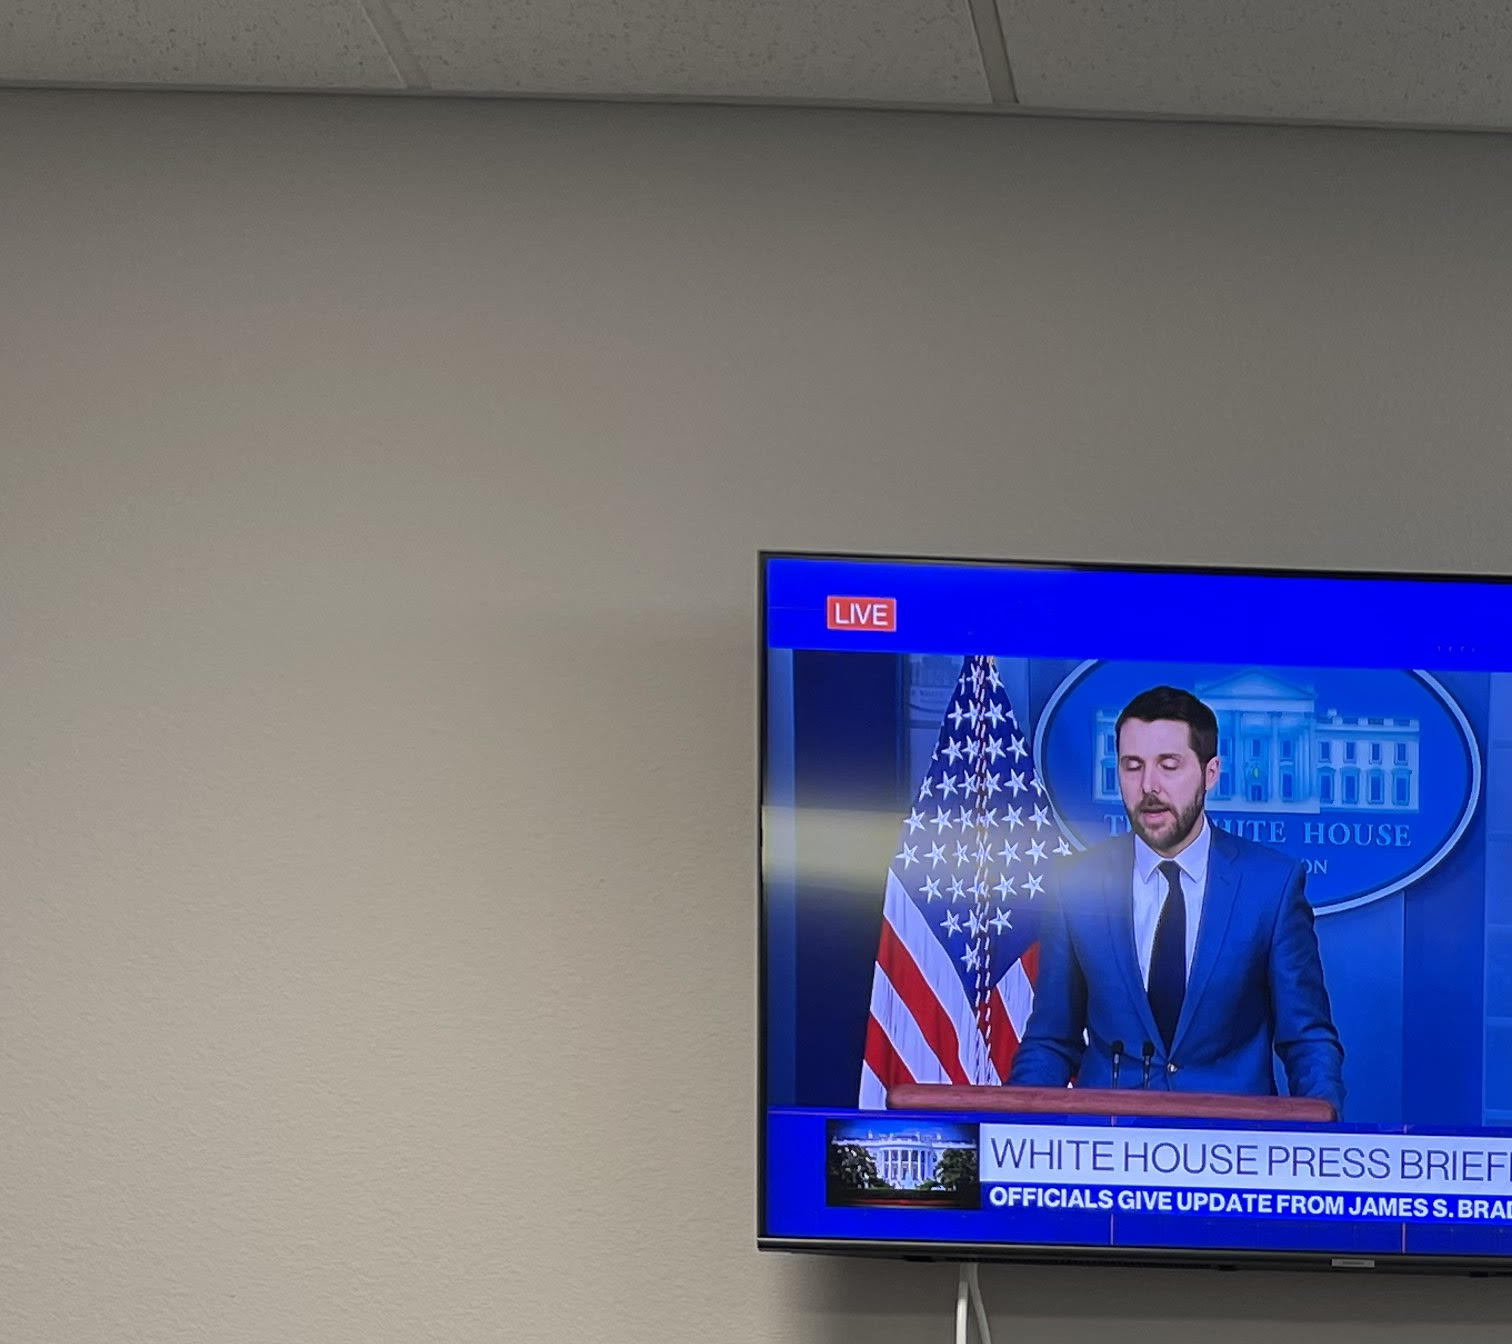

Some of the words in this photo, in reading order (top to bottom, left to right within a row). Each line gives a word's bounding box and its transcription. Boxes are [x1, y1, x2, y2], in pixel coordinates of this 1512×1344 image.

[835, 602, 889, 626] LIVE
[1303, 822, 1412, 848] HOUSE
[989, 1136, 1115, 1172] WHITE
[1123, 1140, 1259, 1176] HOUSE
[1267, 1145, 1392, 1180] PRESS
[988, 1185, 1114, 1210] OFFICIALS
[1117, 1189, 1173, 1212] GIVE
[1176, 1191, 1274, 1214] UPDATE
[1277, 1194, 1345, 1216] FROM
[1348, 1195, 1429, 1218] JAMES
[1432, 1197, 1454, 1219] S.
